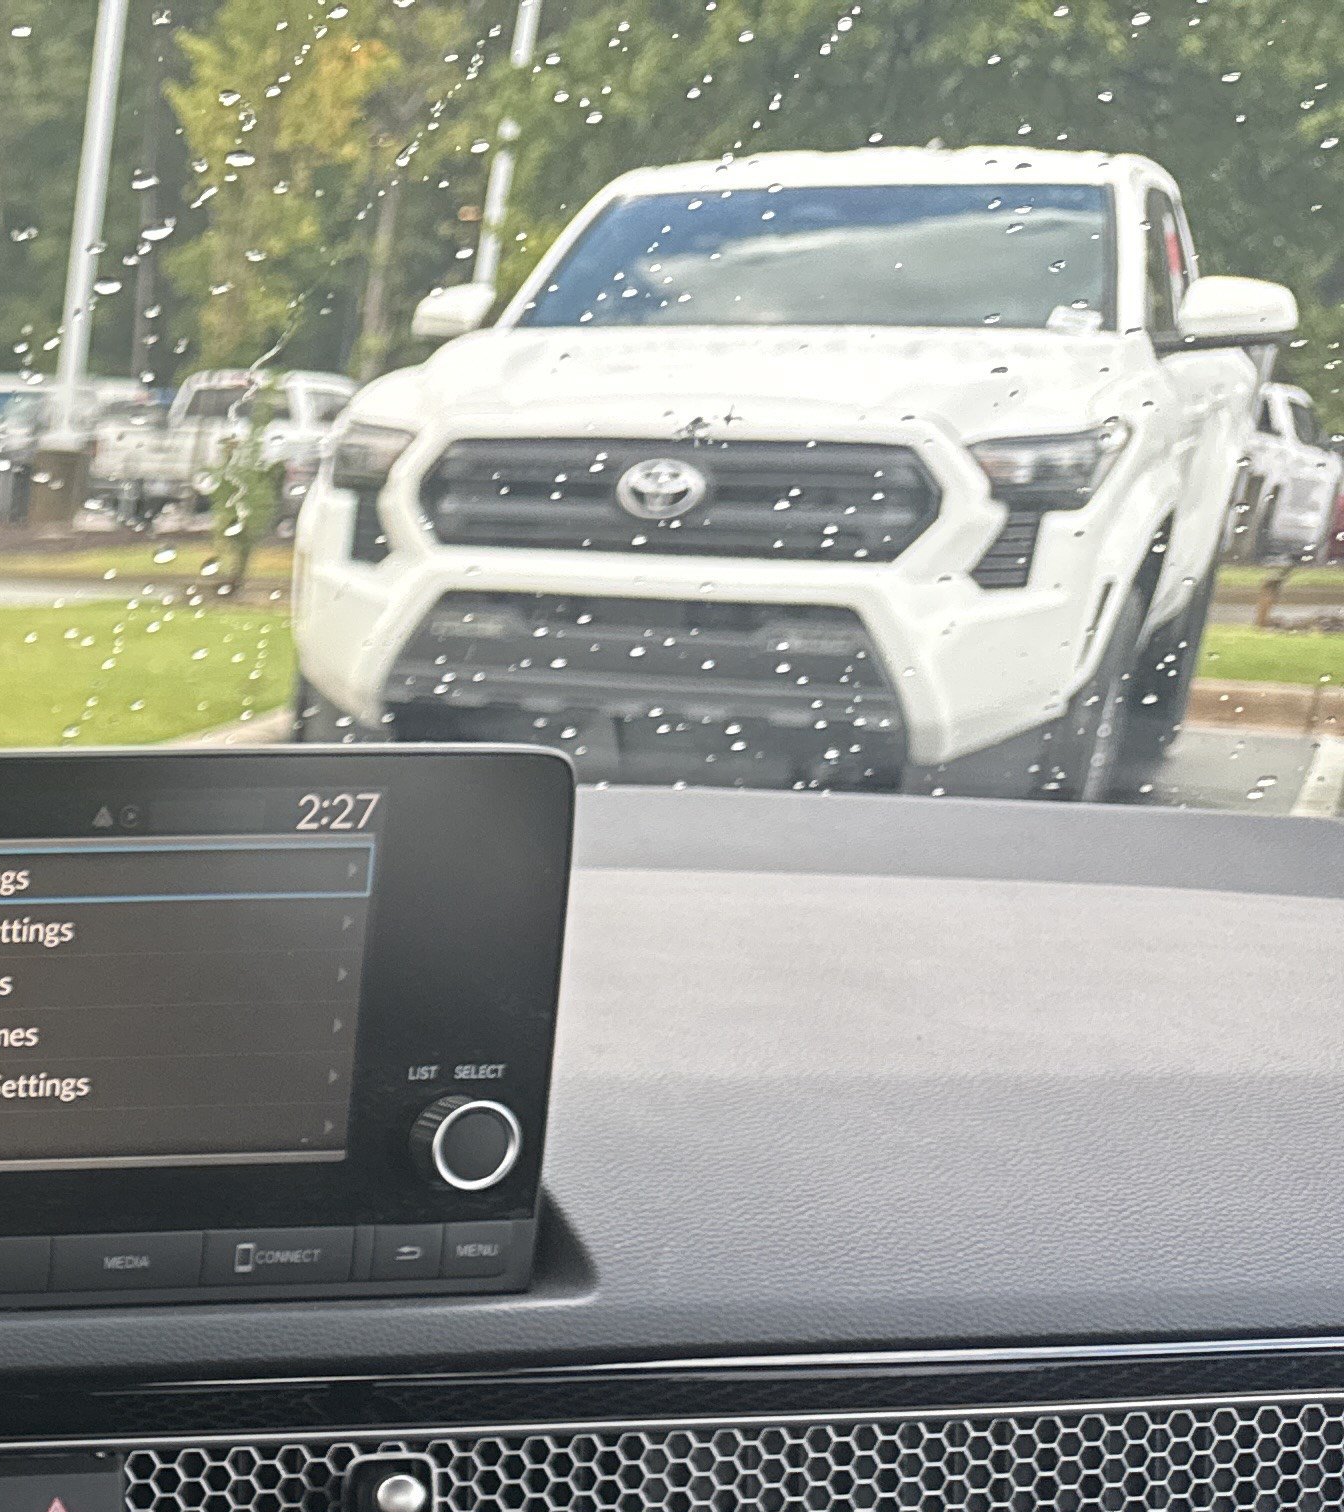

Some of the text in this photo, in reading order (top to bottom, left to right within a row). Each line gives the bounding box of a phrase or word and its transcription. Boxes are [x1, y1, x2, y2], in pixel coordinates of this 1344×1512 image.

[296, 793, 382, 830] 2:27
[408, 1065, 440, 1081] LIST
[453, 1063, 506, 1080] SELECT
[255, 1248, 321, 1264] CONNECT
[456, 1243, 499, 1258] MENU
[103, 1255, 151, 1270] MEDIA
